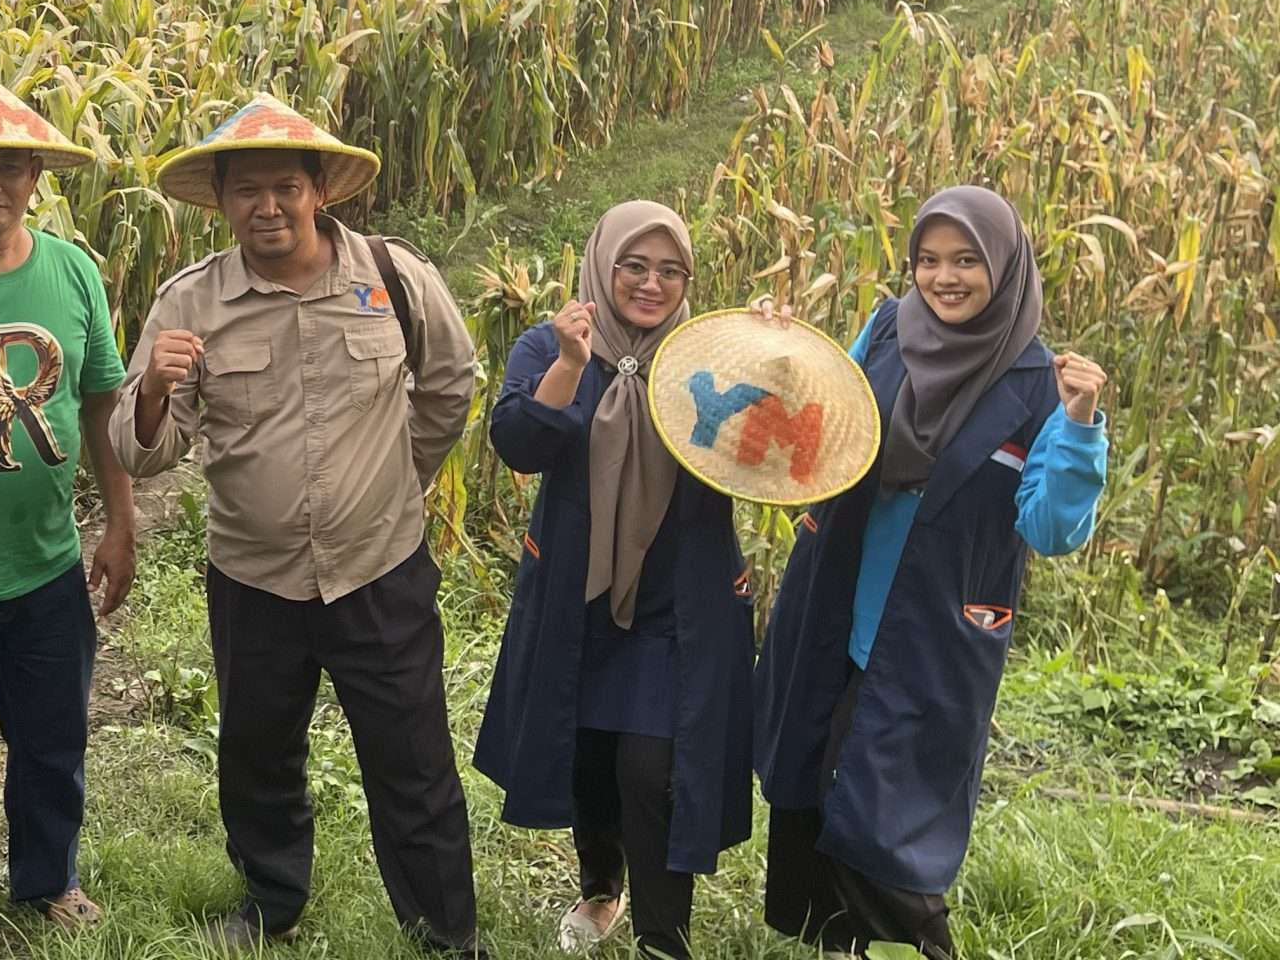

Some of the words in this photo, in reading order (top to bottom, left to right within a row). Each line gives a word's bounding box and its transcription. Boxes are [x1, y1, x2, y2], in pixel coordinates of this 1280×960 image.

[197, 104, 316, 144] M
[353, 287, 388, 307] YM
[688, 370, 824, 485] YM
